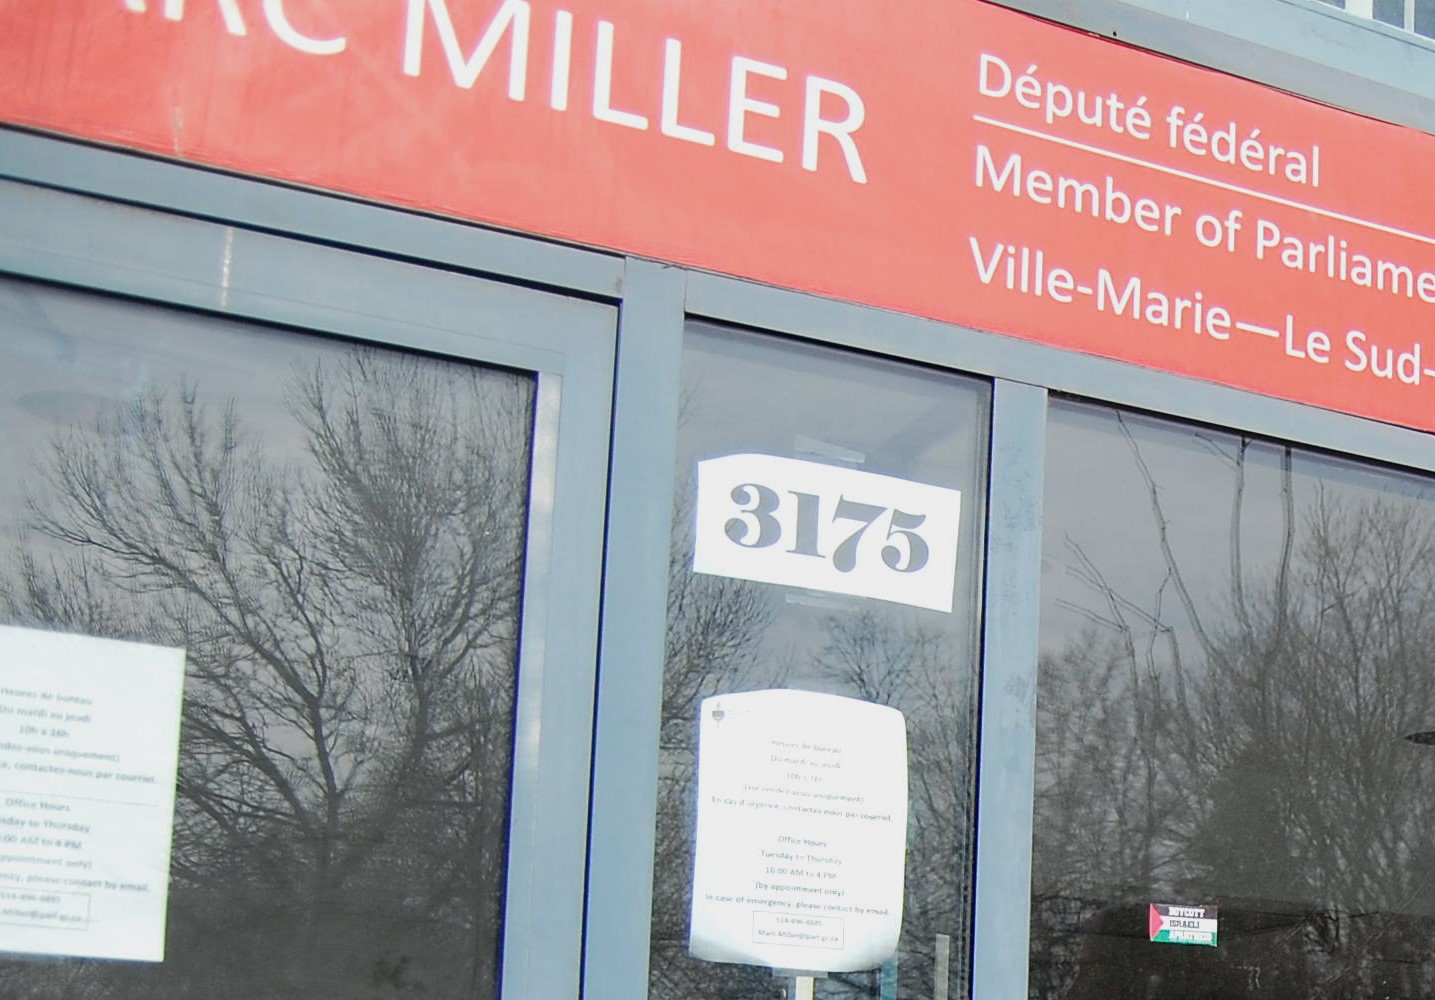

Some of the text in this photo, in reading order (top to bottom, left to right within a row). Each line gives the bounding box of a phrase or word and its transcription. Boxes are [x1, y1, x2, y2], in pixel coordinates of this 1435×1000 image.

[402, 0, 869, 184] MILLER
[978, 52, 1321, 187] Député fédéral
[974, 144, 1183, 236] Member
[1195, 209, 1243, 253] of
[723, 482, 930, 574] 3175
